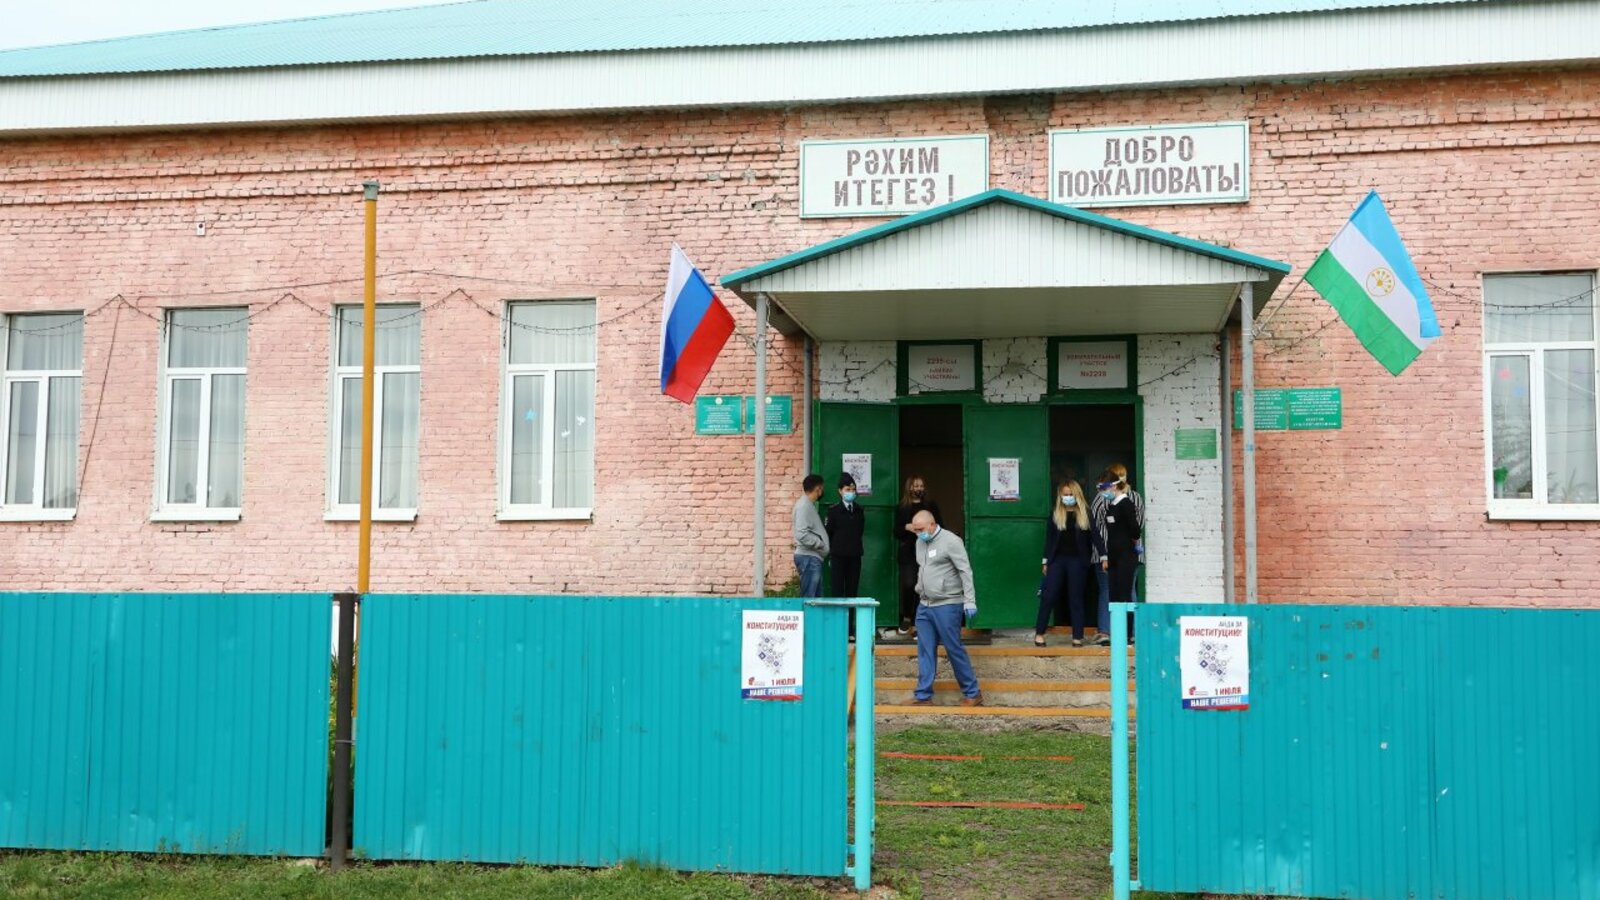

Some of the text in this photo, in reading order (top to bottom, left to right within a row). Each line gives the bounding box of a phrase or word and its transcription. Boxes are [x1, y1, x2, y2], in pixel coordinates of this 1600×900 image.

[1104, 135, 1194, 167] ДОБРО
[847, 147, 939, 176] РӘХИМ
[1058, 163, 1240, 198] ПОЖАЛОВАТЬ!
[1185, 628, 1242, 638] КОНСТИТУЦИЮ!
[776, 678, 796, 686] ИЮЛЯ
[749, 688, 767, 696] НАШЕ
[1219, 686, 1242, 695] ИЮЛЯ
[1190, 695, 1242, 707] НАШЕ РЕШЕНИЕ
